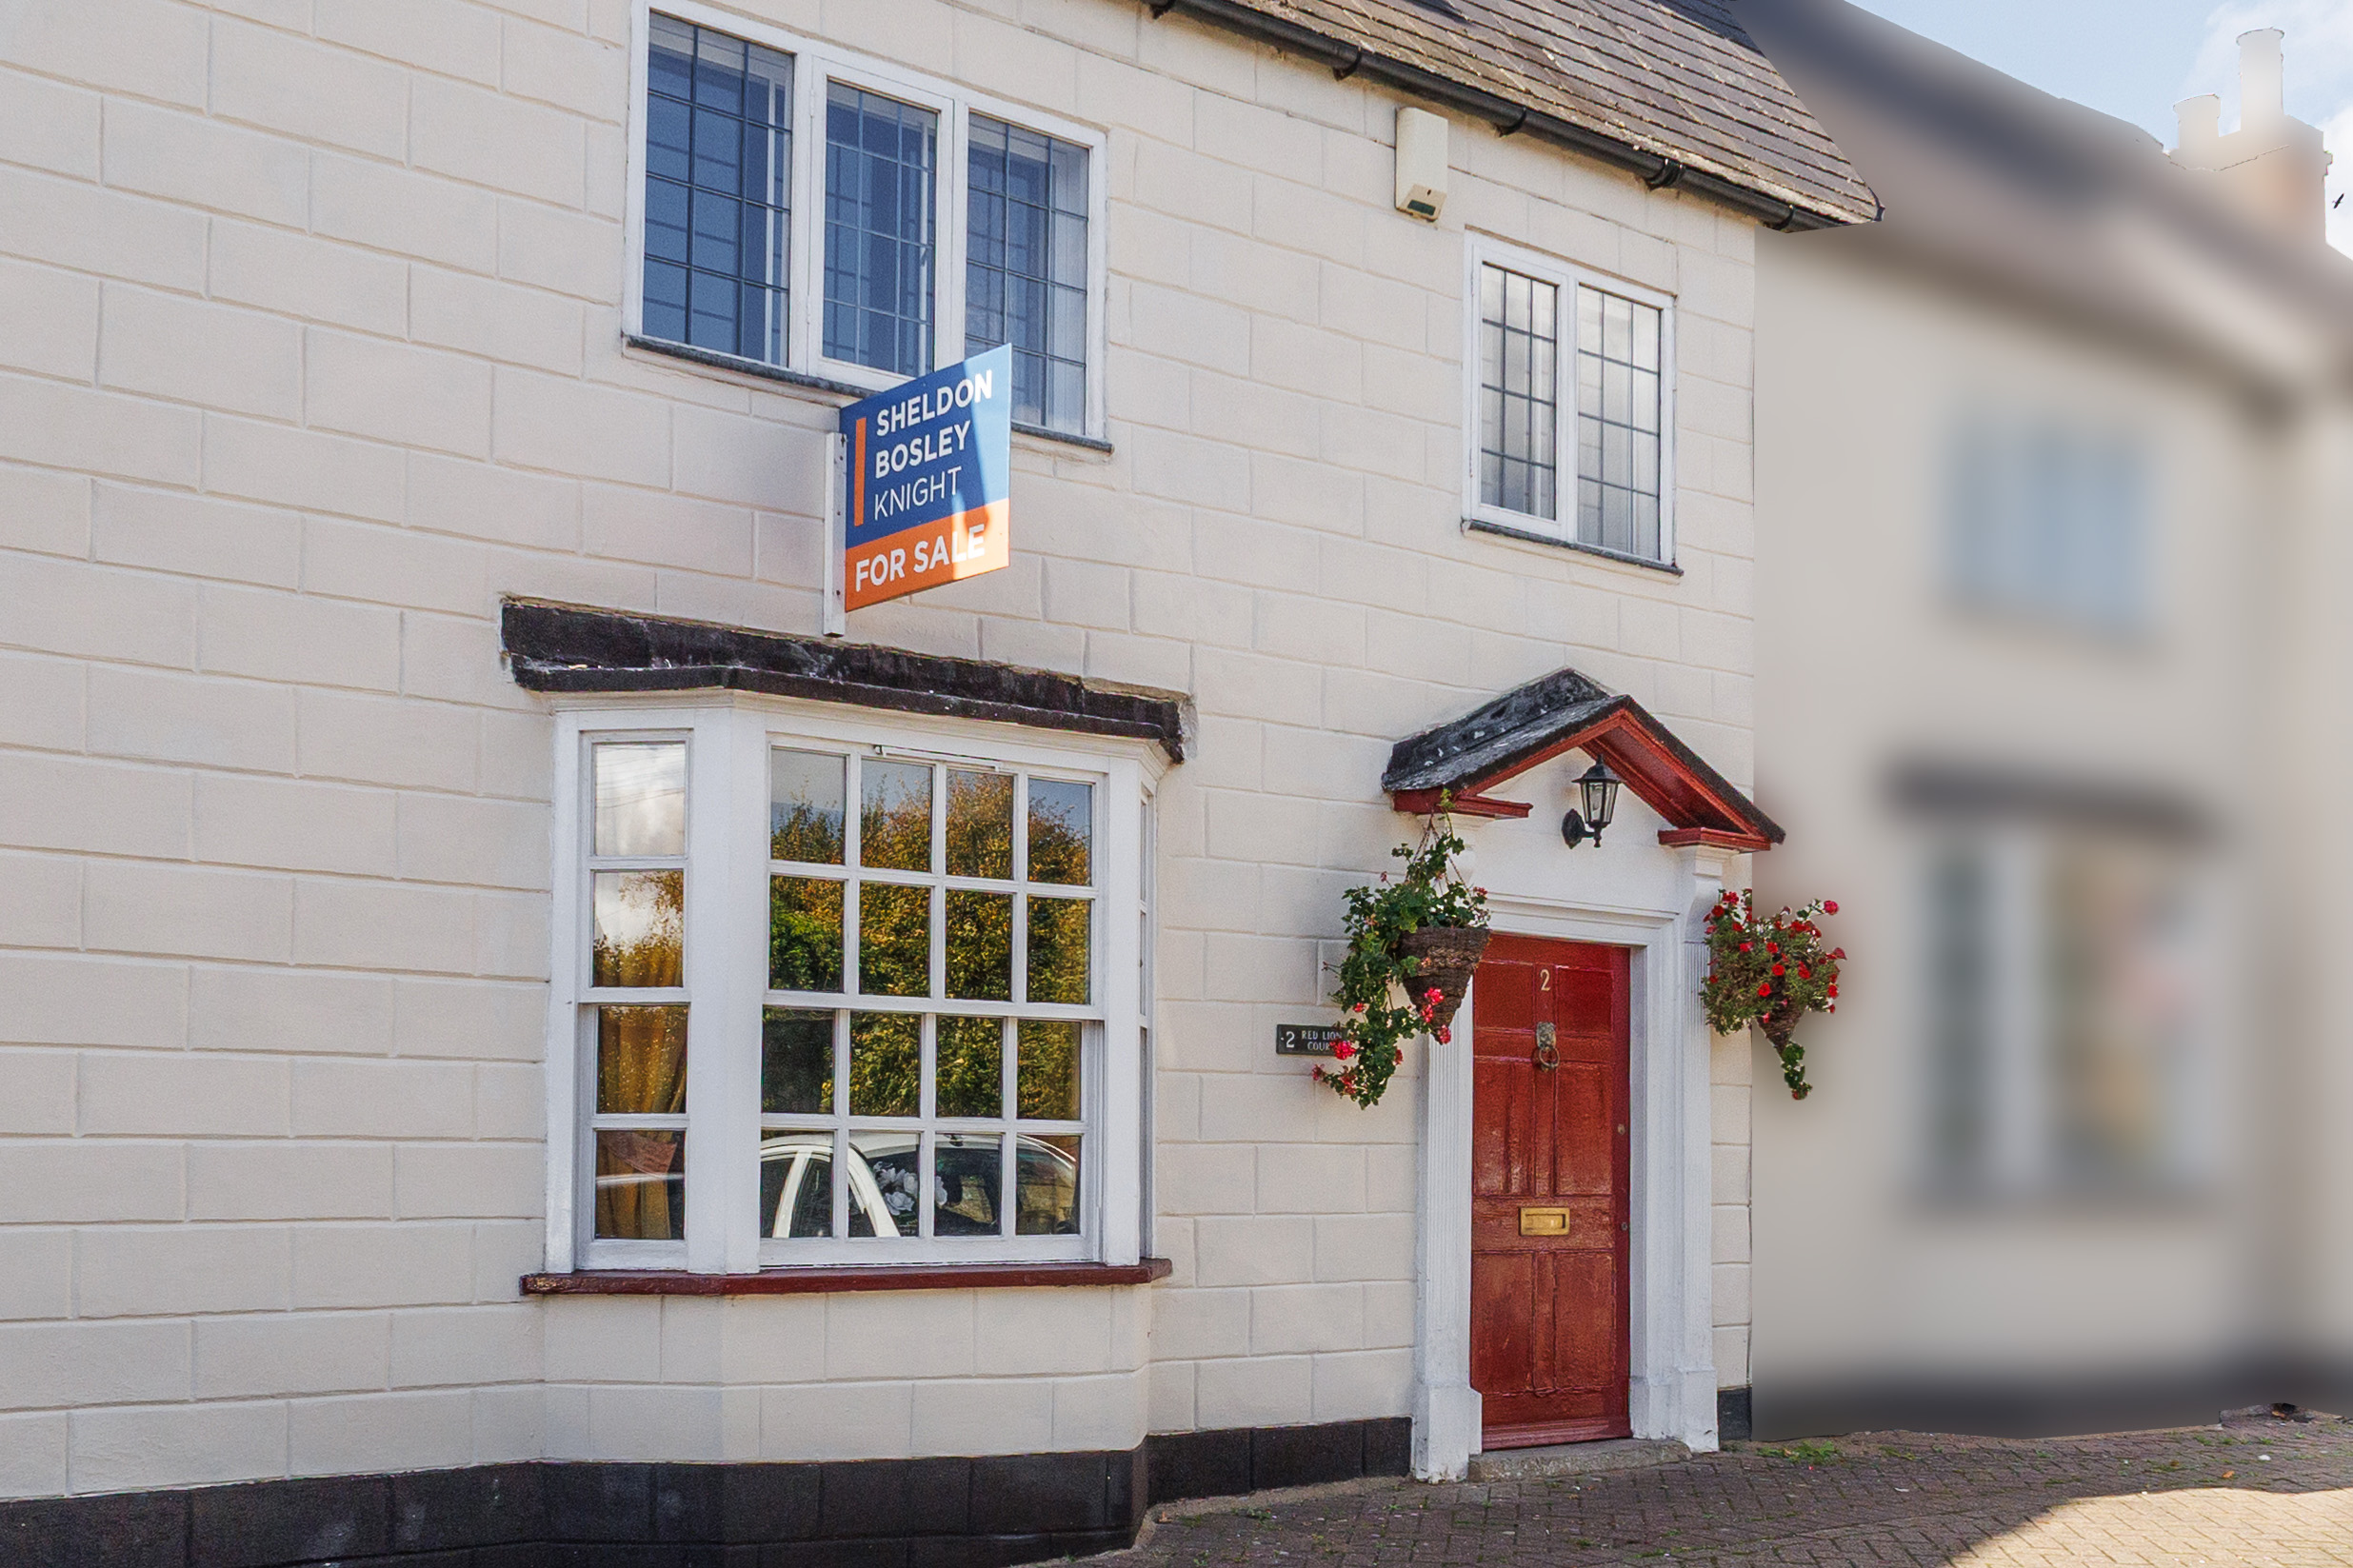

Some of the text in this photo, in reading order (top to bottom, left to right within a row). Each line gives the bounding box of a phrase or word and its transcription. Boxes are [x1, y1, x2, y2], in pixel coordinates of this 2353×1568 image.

[876, 368, 992, 436] SHELDON
[875, 420, 971, 479] BOSLEY
[874, 466, 962, 521] KNIGHT
[855, 524, 985, 592] FOR SALE
[1540, 969, 1551, 991] 2
[1286, 1030, 1295, 1048] 2
[1301, 1030, 1319, 1040] RED
[1307, 1042, 1330, 1051] COUR
